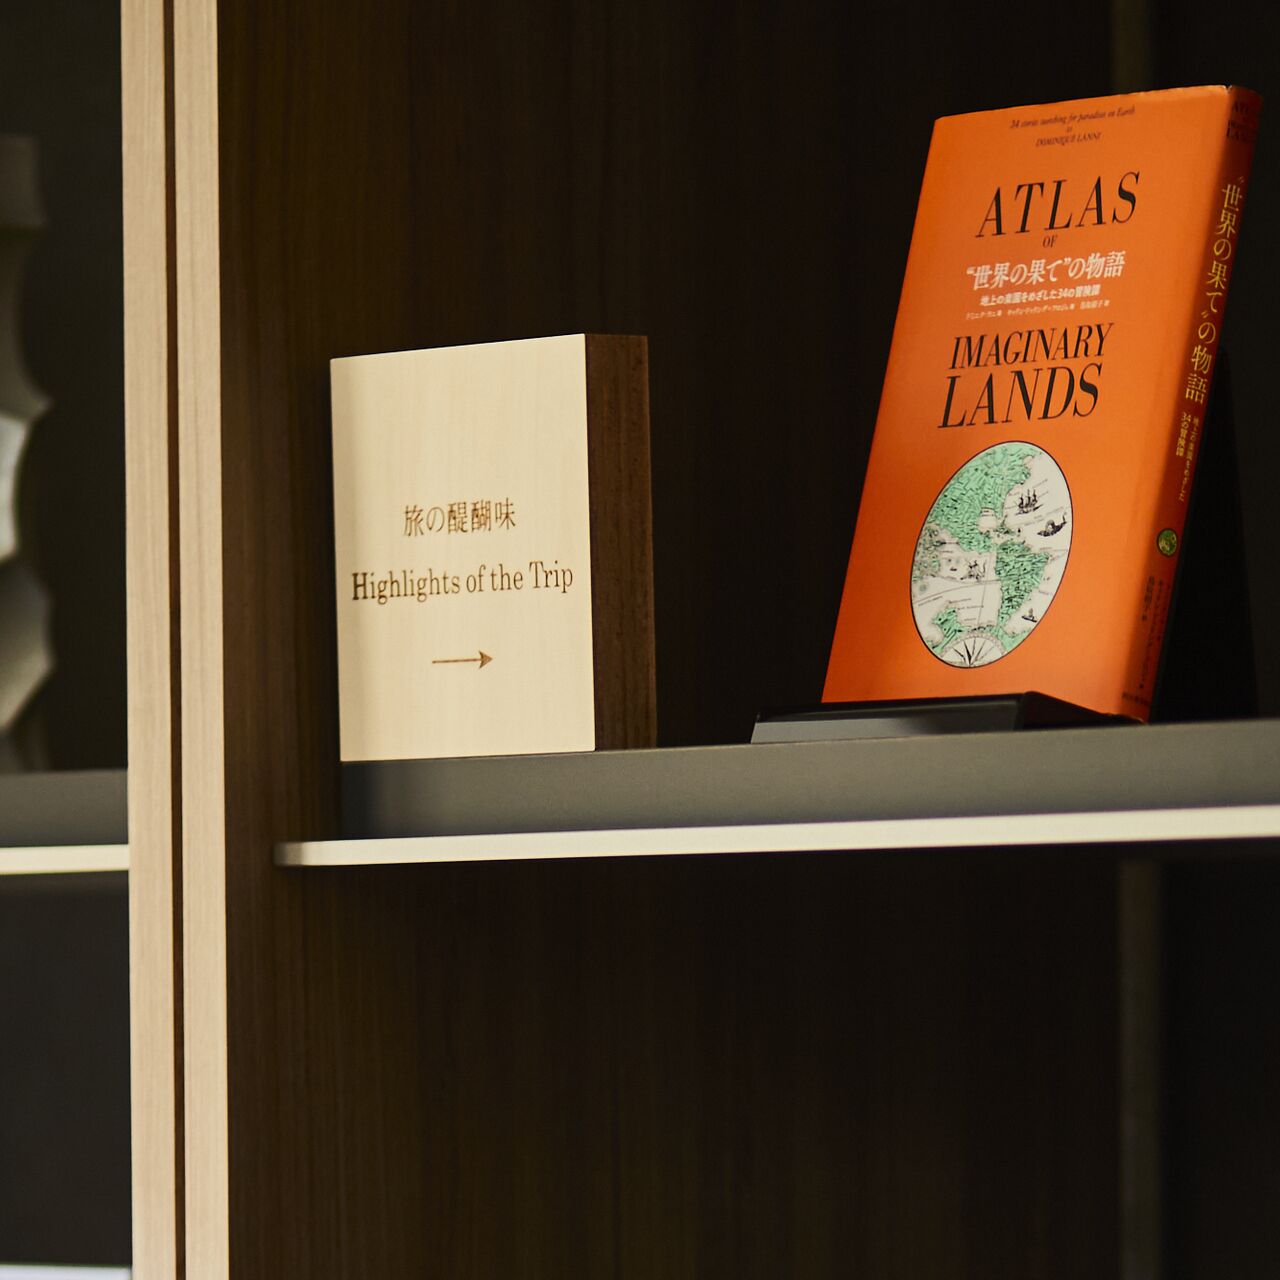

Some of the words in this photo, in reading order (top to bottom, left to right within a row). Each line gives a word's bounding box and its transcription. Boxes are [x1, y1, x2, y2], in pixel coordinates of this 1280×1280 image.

[975, 170, 1141, 239] ATLAS
[1042, 234, 1059, 249] OF
[948, 322, 1115, 370] IMAGINARY
[937, 362, 1102, 429] LANDS
[402, 496, 517, 538] 旅の醍醐味
[351, 568, 461, 606] Highlights
[465, 564, 487, 593] of
[489, 562, 525, 594] the
[528, 559, 575, 595] Trip
